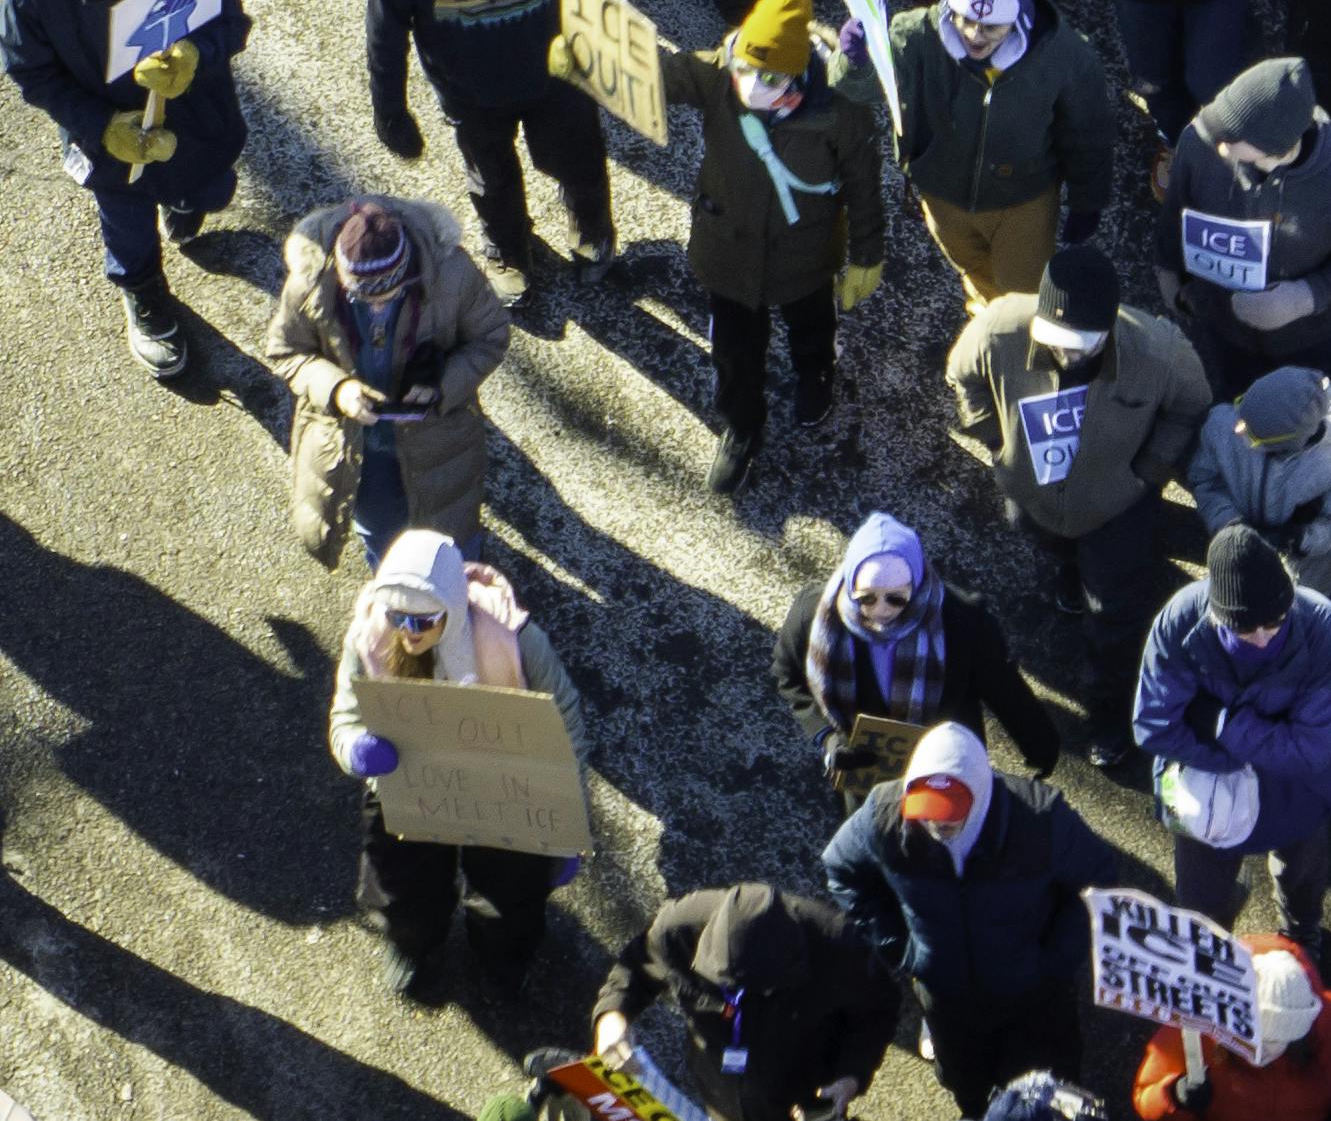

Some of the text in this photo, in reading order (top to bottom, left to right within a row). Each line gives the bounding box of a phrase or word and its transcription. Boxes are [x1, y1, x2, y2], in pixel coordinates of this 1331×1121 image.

[571, 31, 659, 129] OUT!
[1202, 228, 1246, 257] ICE
[1194, 253, 1255, 285] OUT
[458, 717, 526, 748] OUT
[417, 796, 560, 831] MELT ICE
[1102, 913, 1250, 991] ICE
[1110, 896, 1235, 963] KILLER
[1101, 962, 1254, 1040] STREETS
